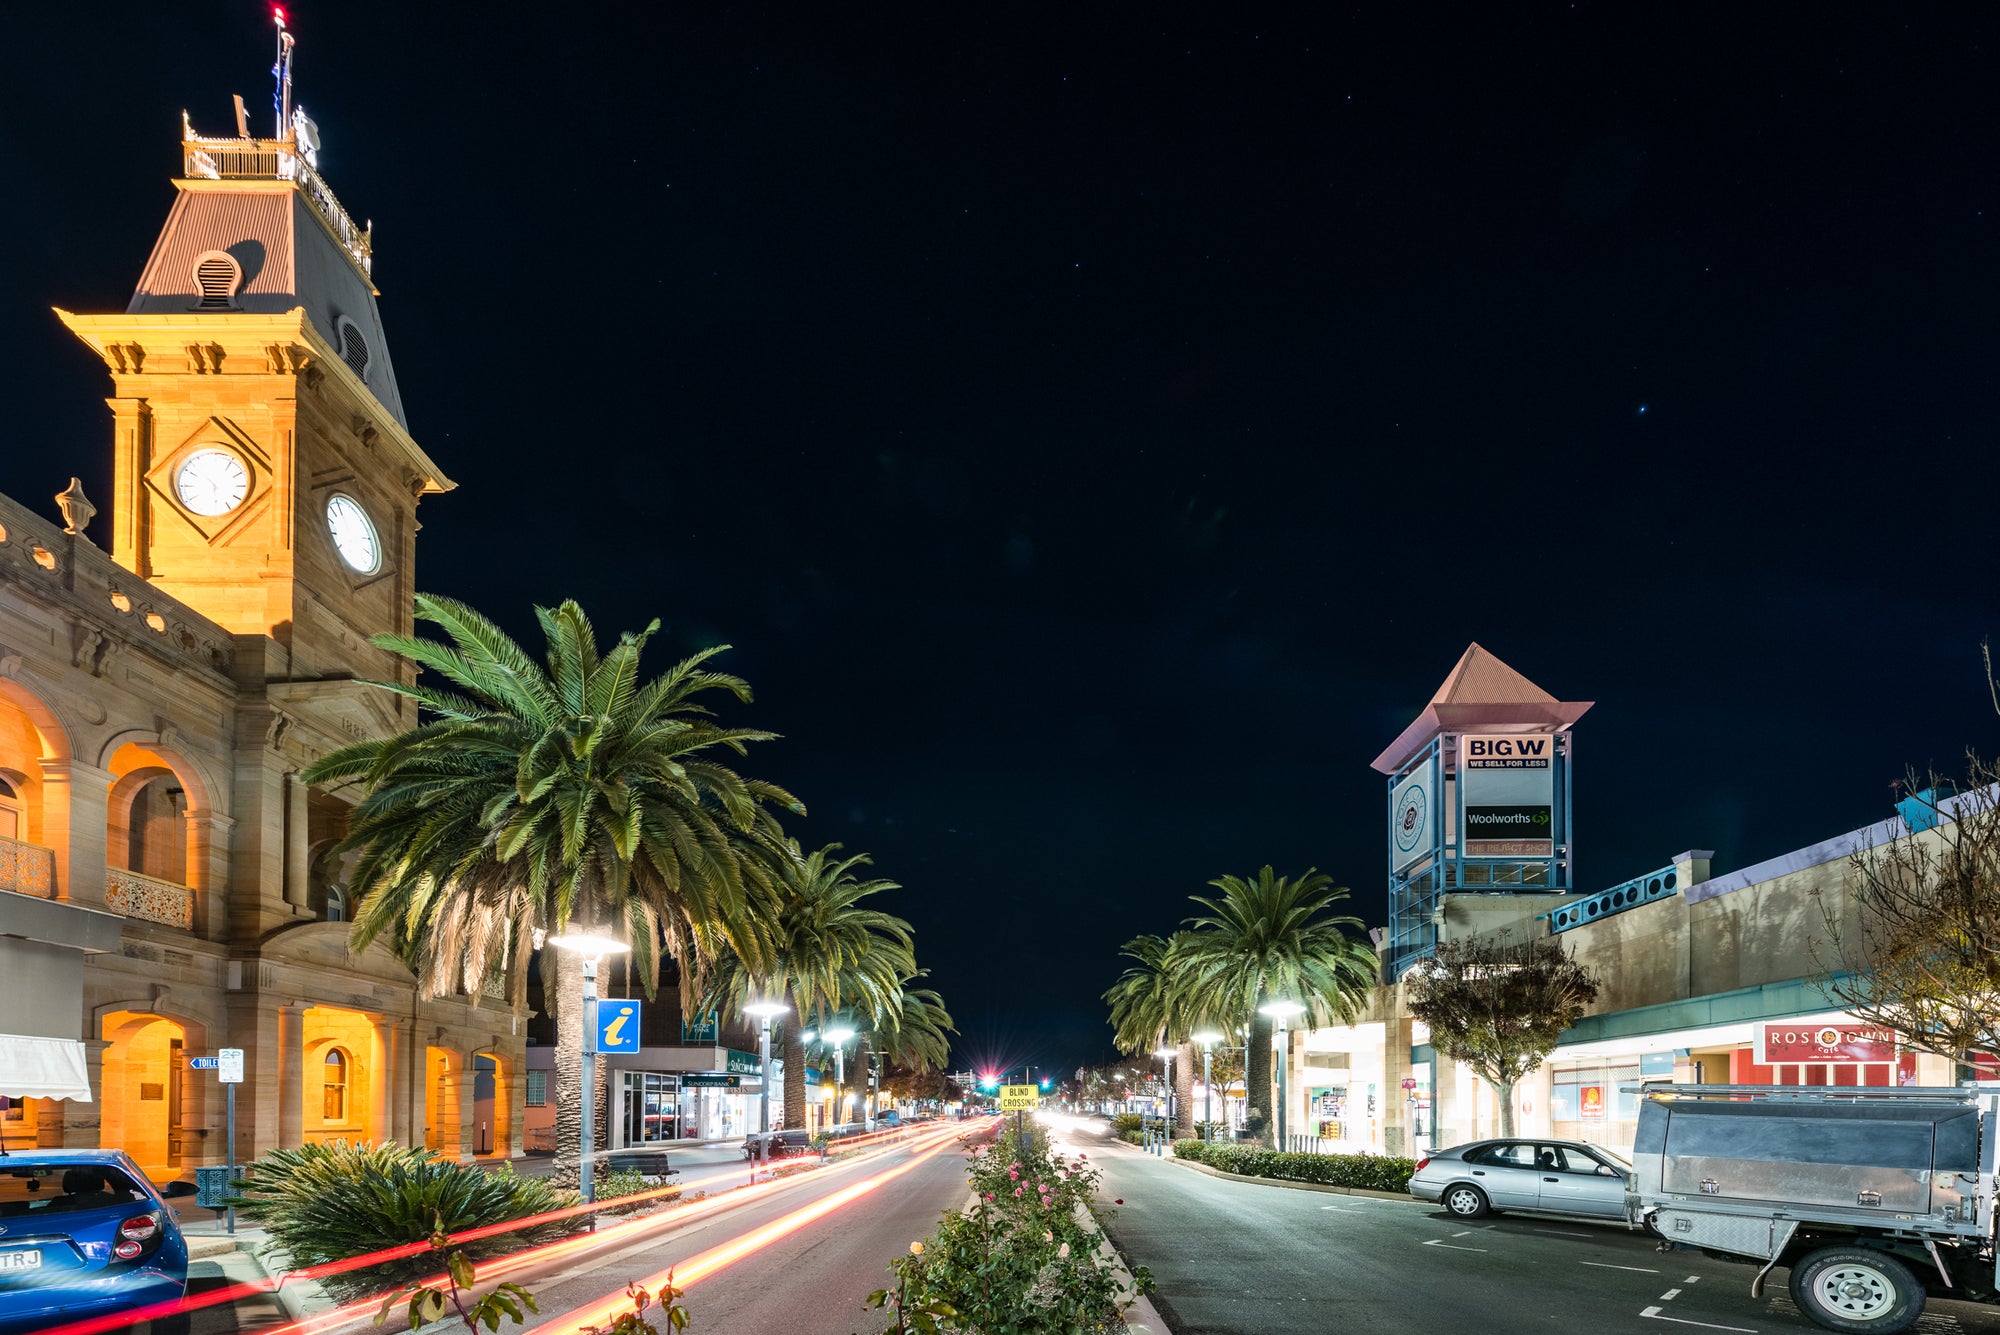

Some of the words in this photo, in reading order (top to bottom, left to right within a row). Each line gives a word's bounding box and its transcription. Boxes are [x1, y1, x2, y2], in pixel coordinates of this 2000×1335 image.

[1470, 740, 1512, 756] BIG
[1516, 740, 1545, 755] W
[1468, 813, 1531, 824] Woolworths
[1467, 844, 1484, 852] THE
[1487, 843, 1523, 853] REJECT
[1525, 843, 1550, 852] SHOP
[221, 1051, 241, 1059] 2P
[1009, 1088, 1029, 1096] BLIND
[1003, 1099, 1035, 1107] CROSSING
